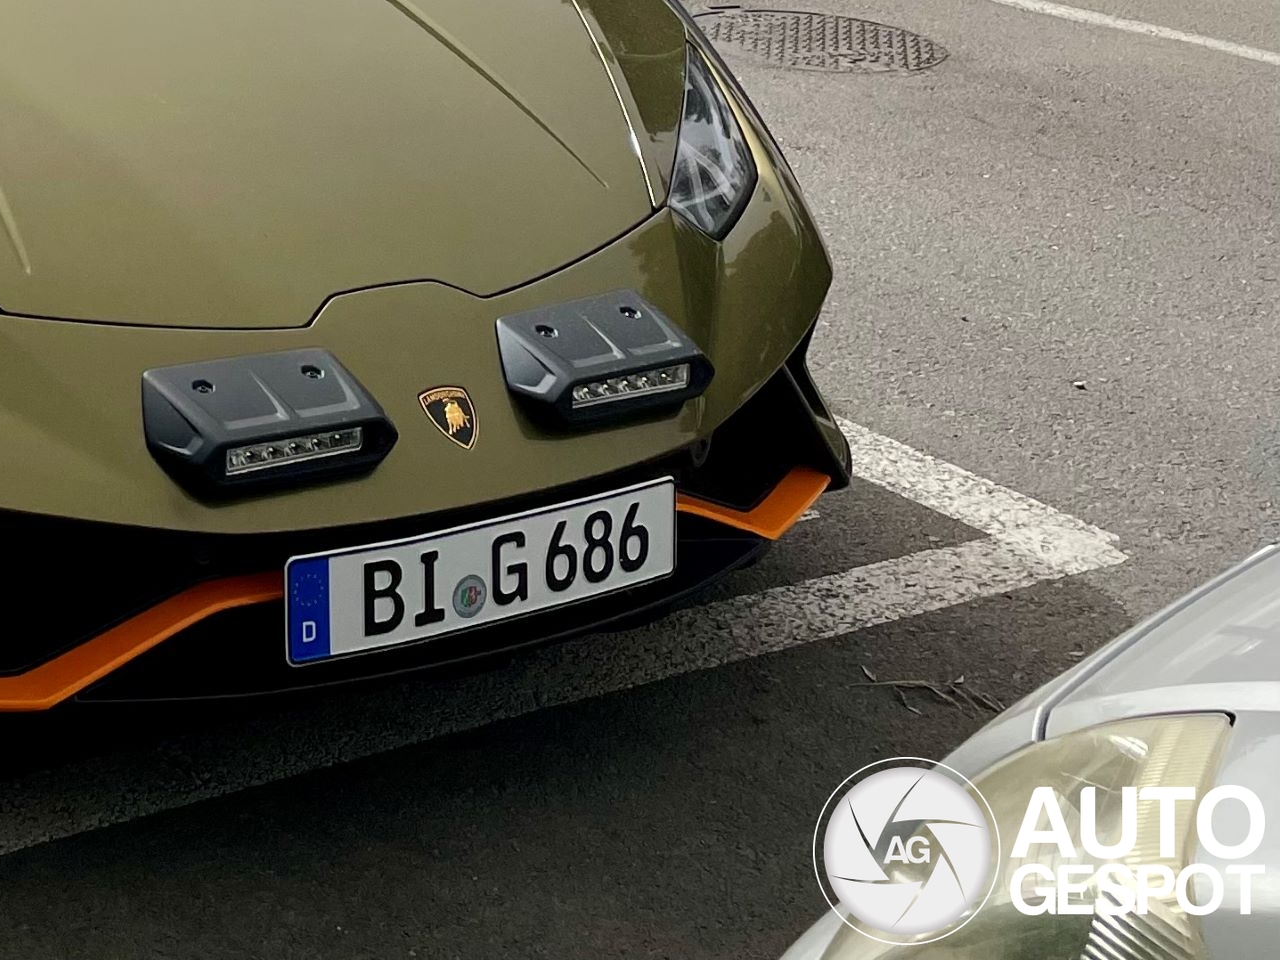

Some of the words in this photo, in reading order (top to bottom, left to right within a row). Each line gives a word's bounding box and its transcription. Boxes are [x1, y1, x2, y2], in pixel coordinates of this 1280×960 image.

[363, 550, 445, 636] BI
[492, 531, 528, 606] G
[546, 502, 649, 592] 686
[302, 620, 316, 643] D
